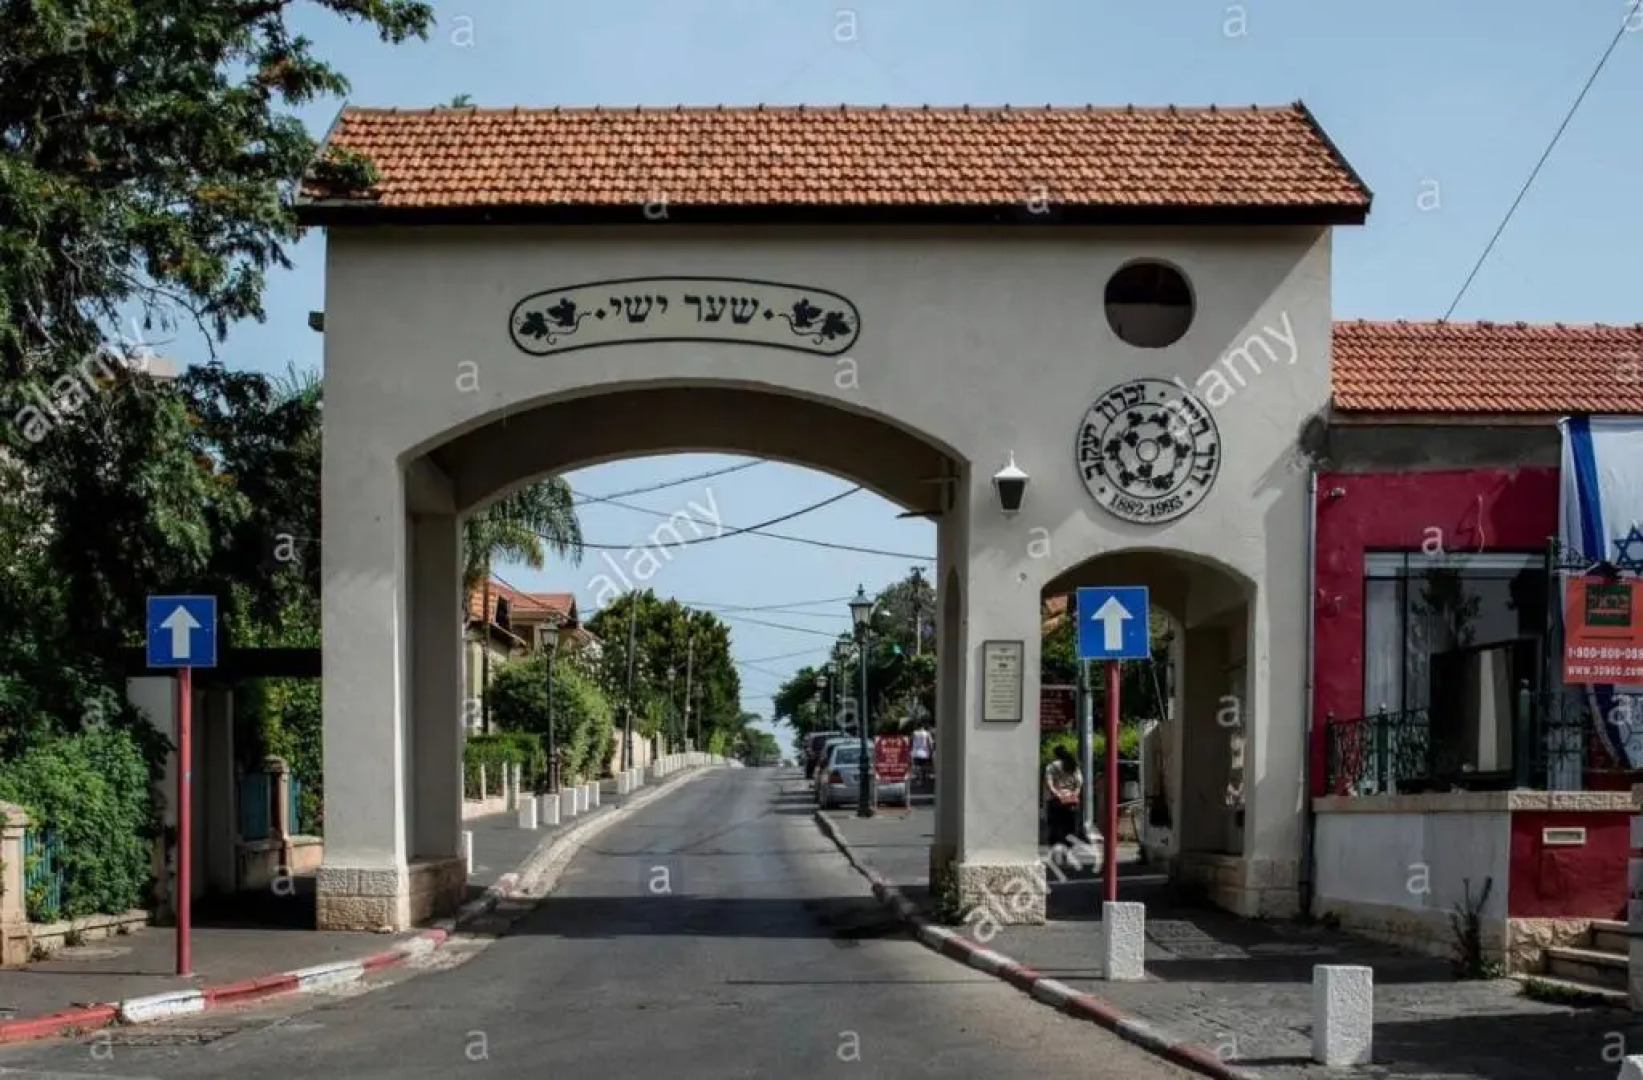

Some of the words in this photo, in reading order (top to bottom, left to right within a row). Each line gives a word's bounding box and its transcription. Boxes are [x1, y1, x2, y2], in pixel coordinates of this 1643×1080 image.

[609, 293, 668, 324] ישי
[684, 293, 760, 324] שער
[1094, 384, 1146, 424] זכרון
[1081, 423, 1106, 481] יעקב
[1191, 442, 1217, 486] דרך
